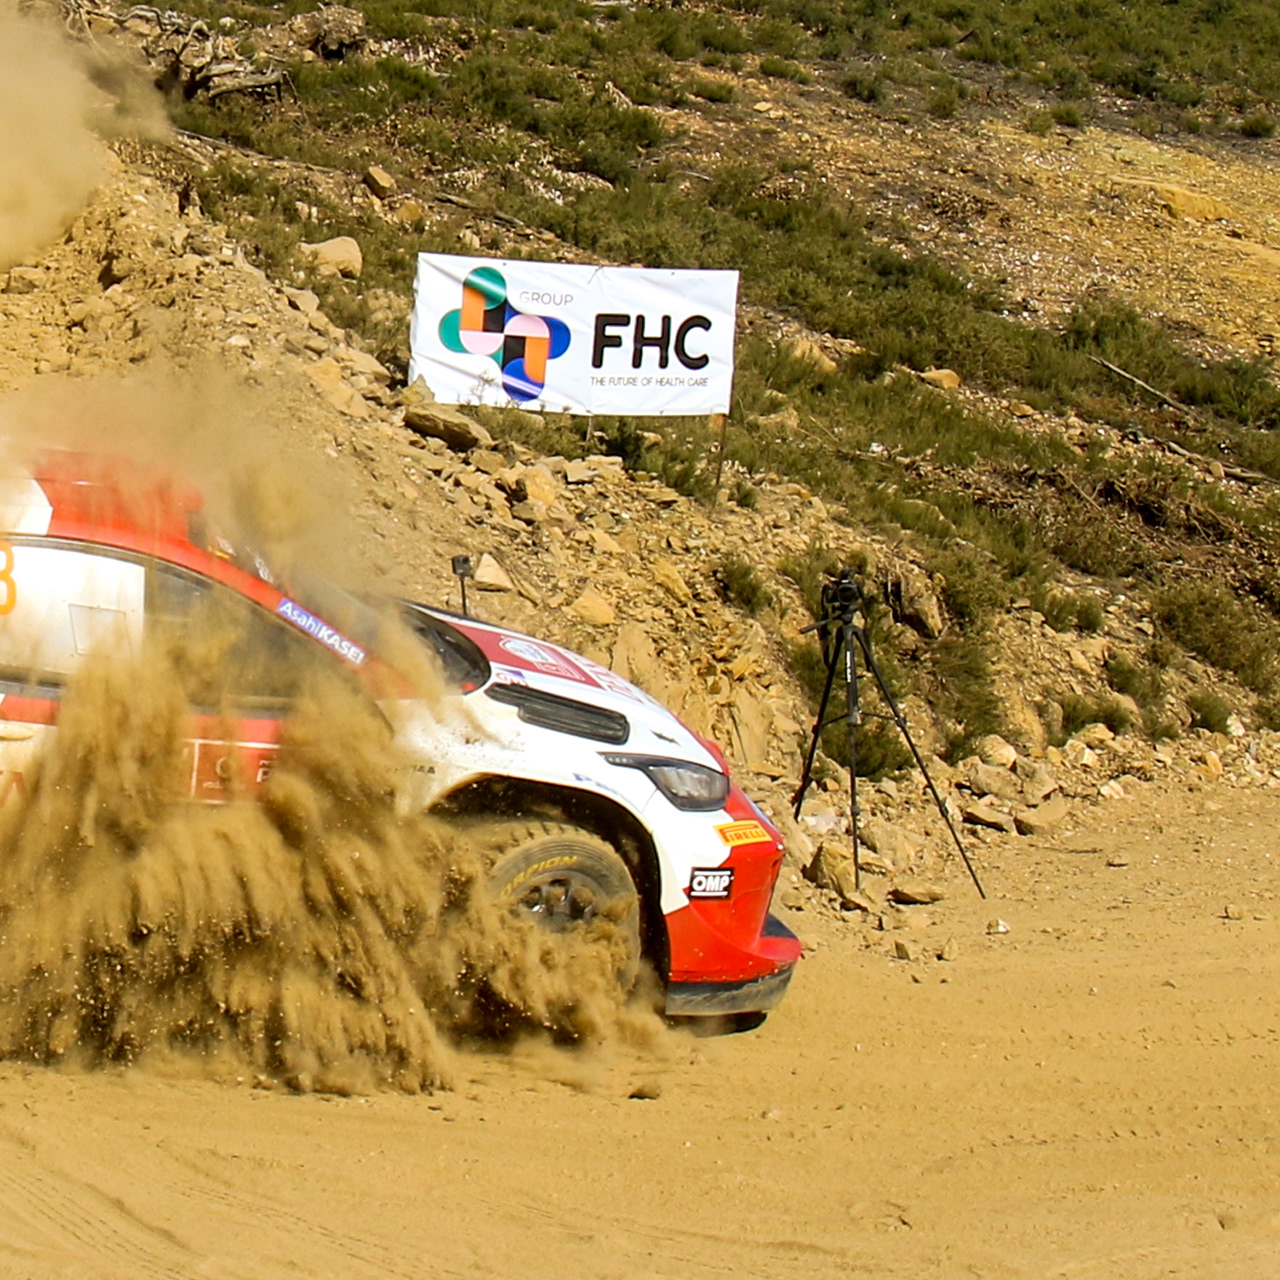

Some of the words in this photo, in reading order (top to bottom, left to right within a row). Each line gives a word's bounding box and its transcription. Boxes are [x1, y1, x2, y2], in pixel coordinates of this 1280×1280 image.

[519, 291, 574, 306] GROUP
[592, 313, 713, 370] FHC
[590, 376, 606, 386] THE
[608, 377, 638, 387] FUTURE
[640, 377, 653, 386] OF
[655, 377, 685, 387] HEALTH
[686, 377, 709, 387] CARE
[718, 823, 768, 843] PIRELLI
[691, 876, 730, 893] OMP
